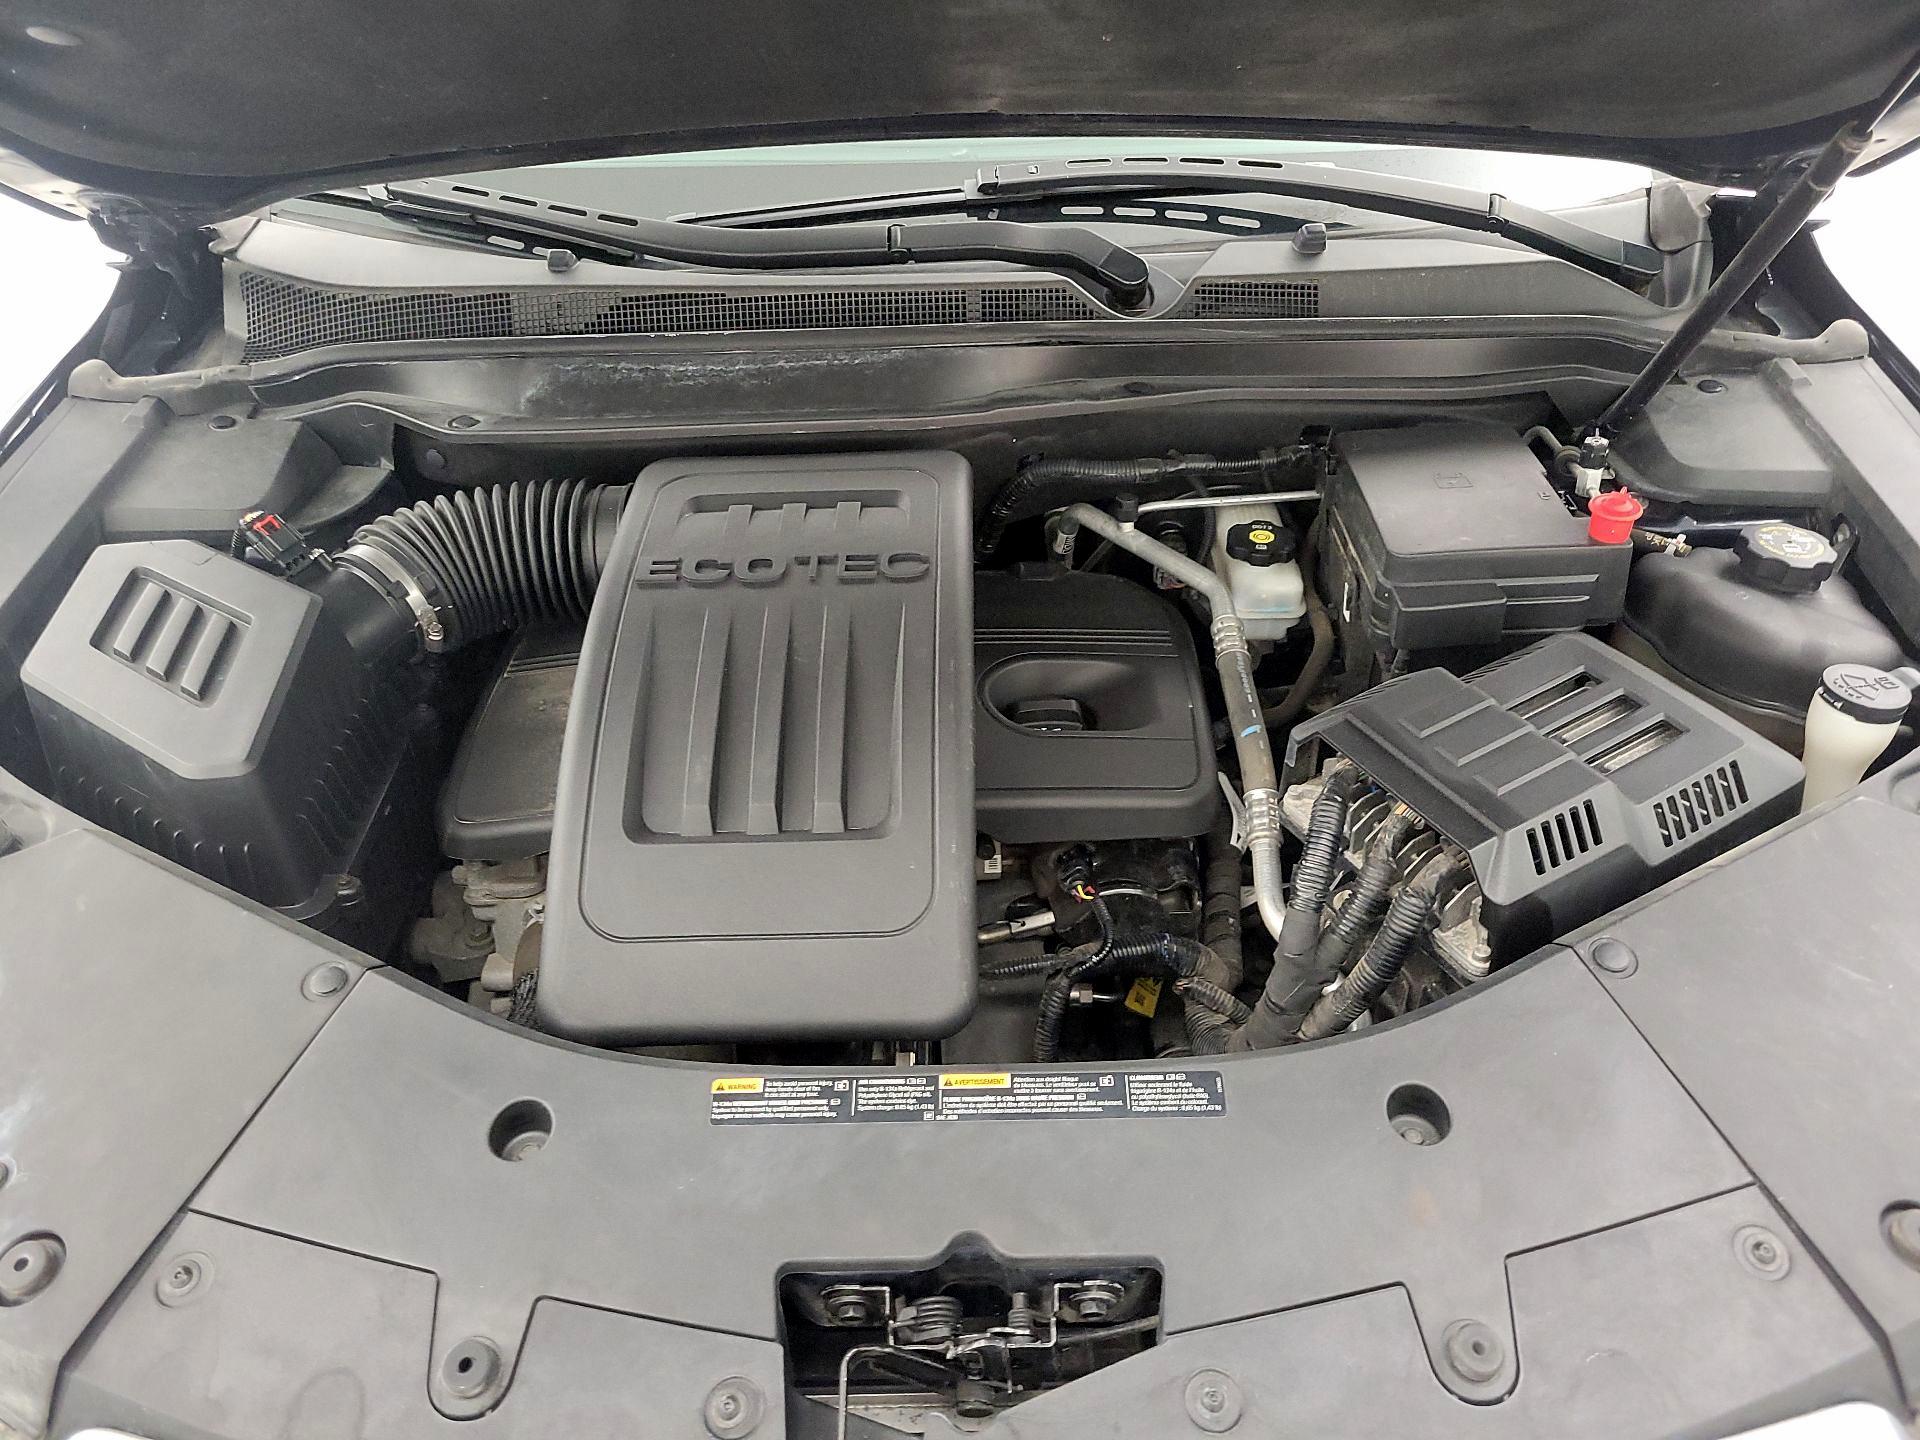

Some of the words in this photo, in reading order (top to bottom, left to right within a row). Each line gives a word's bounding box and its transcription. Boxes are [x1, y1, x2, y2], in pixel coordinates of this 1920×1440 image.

[634, 551, 931, 586] ECOTEC
[954, 1078, 1005, 1086] AVERTISSEMENT
[727, 1083, 757, 1091] WARNING
